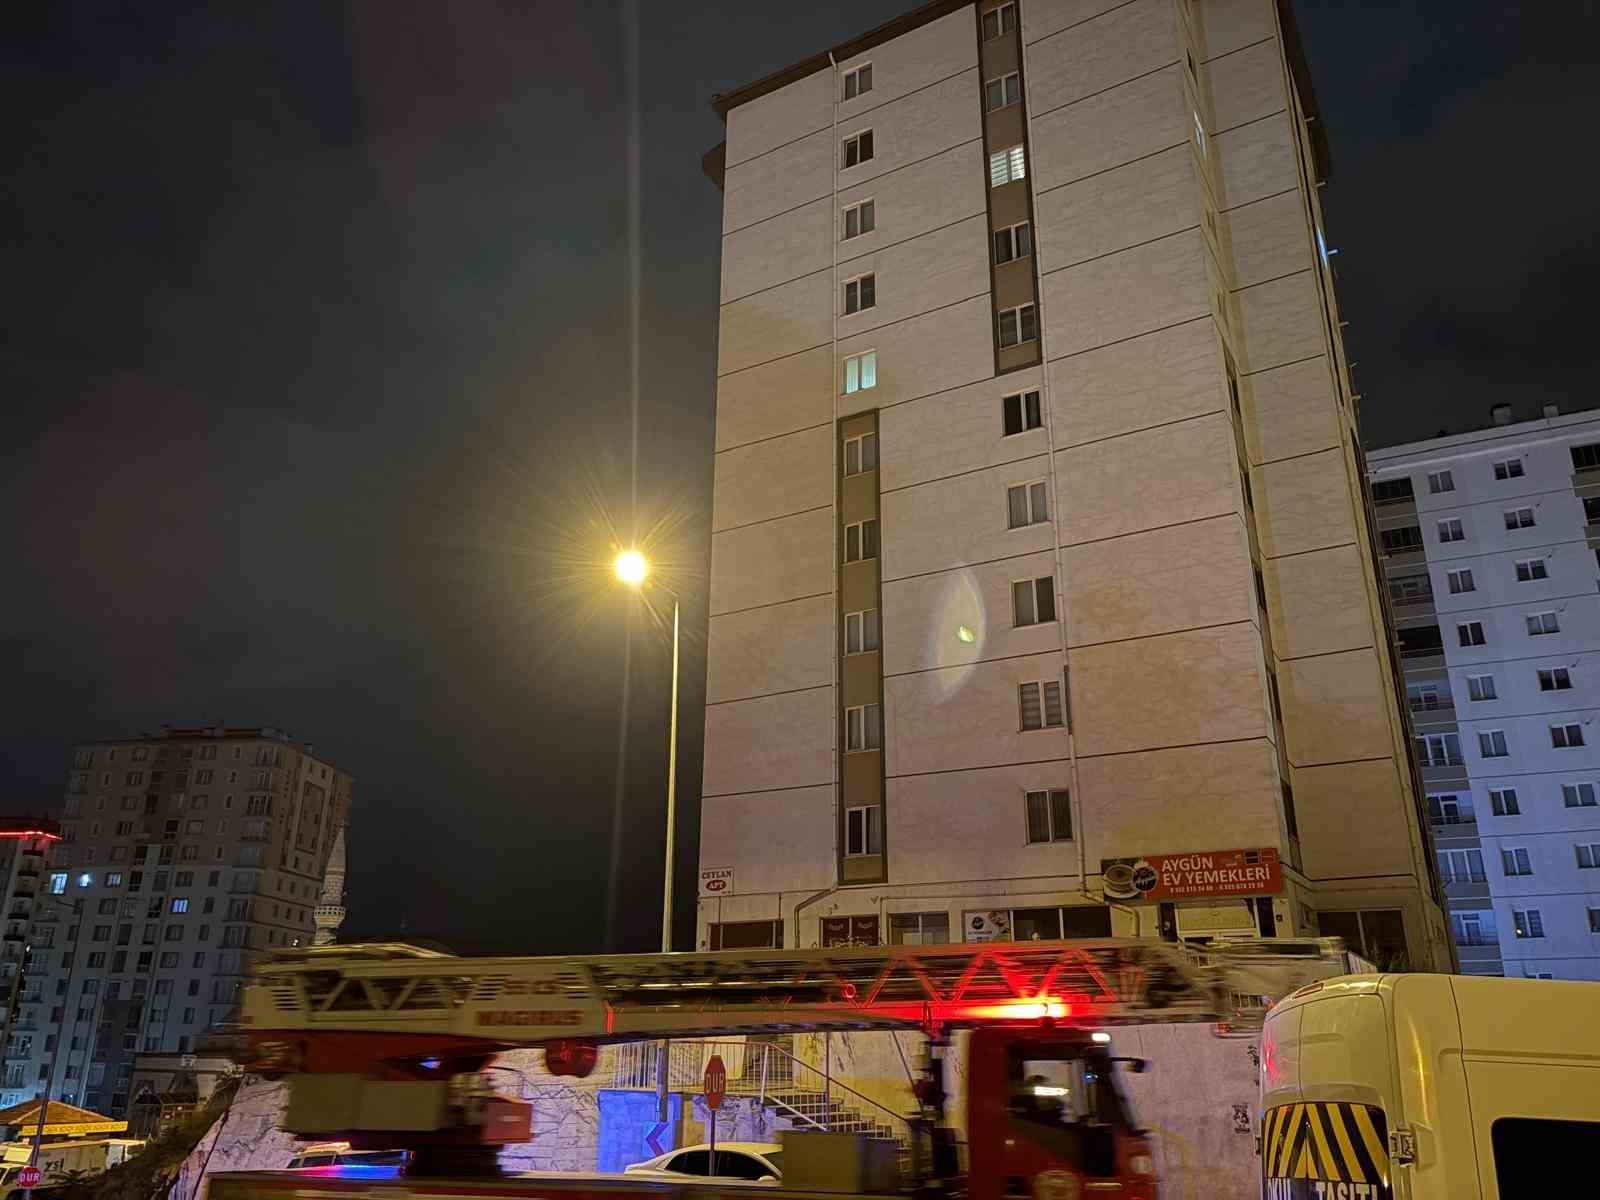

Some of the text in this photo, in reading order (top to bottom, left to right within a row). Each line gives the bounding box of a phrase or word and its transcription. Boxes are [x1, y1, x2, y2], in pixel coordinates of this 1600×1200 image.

[1162, 855, 1213, 872] AYGÜN
[702, 870, 732, 879] CEYLAN
[1163, 873, 1182, 886] EV
[1183, 864, 1271, 885] YEMEKLERİ
[705, 1072, 725, 1094] DUR
[18, 1172, 40, 1183] DUR
